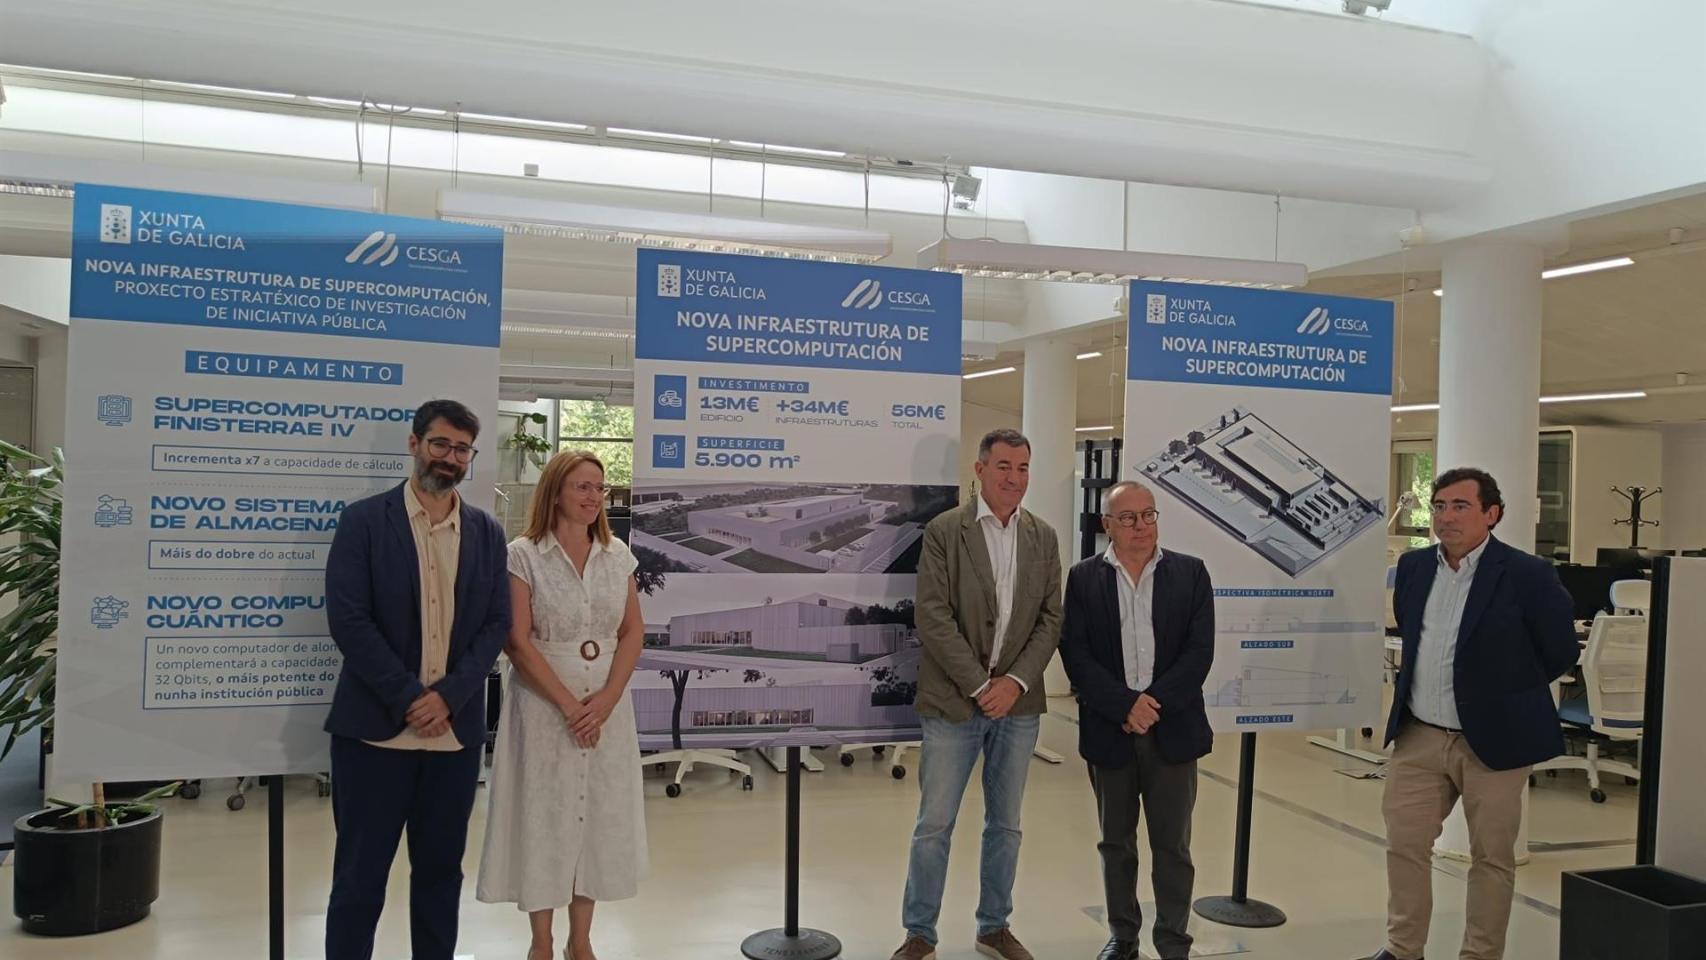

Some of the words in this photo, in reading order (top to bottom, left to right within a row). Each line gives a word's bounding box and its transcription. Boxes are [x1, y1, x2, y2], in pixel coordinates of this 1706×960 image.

[139, 209, 205, 230] XUNTA
[138, 228, 162, 243] DE
[168, 231, 245, 251] GALICIA
[406, 246, 462, 265] CESGA
[86, 258, 136, 276] NOVA
[140, 262, 295, 289] INFRAESTRUTURA
[300, 276, 321, 290] DE
[326, 277, 491, 306] SUPERCOMPUTACIÓN,
[686, 268, 736, 284] XUNTA
[685, 284, 704, 296] DE
[709, 285, 766, 300] GALICIA
[888, 291, 931, 306] CESGA
[115, 281, 205, 300] PROXECTO
[211, 285, 320, 309] ESTRATÉXICO
[326, 296, 346, 310] DE
[351, 297, 466, 320] INVESTIGACIÓN
[1170, 298, 1211, 311] XUNTA
[206, 305, 227, 319] DE
[233, 307, 318, 326] INICIATIVA
[322, 310, 386, 332] PÚBLICA
[677, 311, 732, 330] NOVA
[738, 314, 902, 339] INFRAESTRUTURA
[907, 326, 929, 341] DE
[1170, 312, 1185, 323] DE
[1189, 313, 1236, 326] GALICIA
[1334, 318, 1368, 332] CESGA
[706, 335, 902, 361] SUPERCOMPUTACIÓN
[1162, 336, 1207, 353] NOVA
[1212, 338, 1345, 362] INFRAESTRUTURA
[1349, 350, 1367, 364] DE
[198, 355, 392, 381] EQUIPAMENTO
[1186, 358, 1345, 382] SUPERCOMPUTACIÓN
[704, 379, 805, 392] INVESTIMENTO
[700, 396, 759, 412] 13M€
[776, 400, 849, 416] +34M€
[891, 404, 945, 420] 56M€
[154, 415, 323, 436] FINISTERRAE
[330, 422, 355, 437] IV
[700, 414, 743, 423] EDIFICIO
[776, 416, 878, 428] INFRAESTRUTURAS
[892, 421, 923, 430] TOTAL
[702, 438, 780, 449] SUPERFICIE
[164, 452, 241, 465] Incrementa
[245, 455, 260, 466] x7
[263, 458, 271, 466] a
[274, 456, 342, 470] capacidade
[345, 458, 359, 469] de
[362, 458, 403, 471] cálculo
[695, 452, 762, 468] 5.900
[150, 496, 226, 511] NOVO
[235, 498, 346, 514] SISTEMA
[150, 515, 186, 529] DE
[196, 516, 337, 531] ALMACENA
[160, 547, 191, 559] Máis
[195, 548, 212, 559] do
[216, 548, 254, 560] dobre
[259, 549, 274, 560] do
[278, 549, 315, 560] actual
[147, 596, 222, 610] NOVO
[231, 595, 325, 610] COMPU
[146, 608, 284, 628] CUÁNTICO
[156, 644, 174, 654] Un
[178, 646, 209, 654] novo
[213, 642, 288, 657] computador
[293, 642, 308, 652] de
[156, 658, 256, 671] complementará
[271, 656, 338, 671] capacidade
[155, 675, 170, 685] 32
[174, 673, 212, 686] Qbits,
[228, 673, 259, 684] máis
[263, 673, 315, 687] potente
[319, 672, 334, 682] do
[155, 689, 197, 700] nunha
[201, 687, 272, 699] institución
[277, 686, 324, 700] pública
